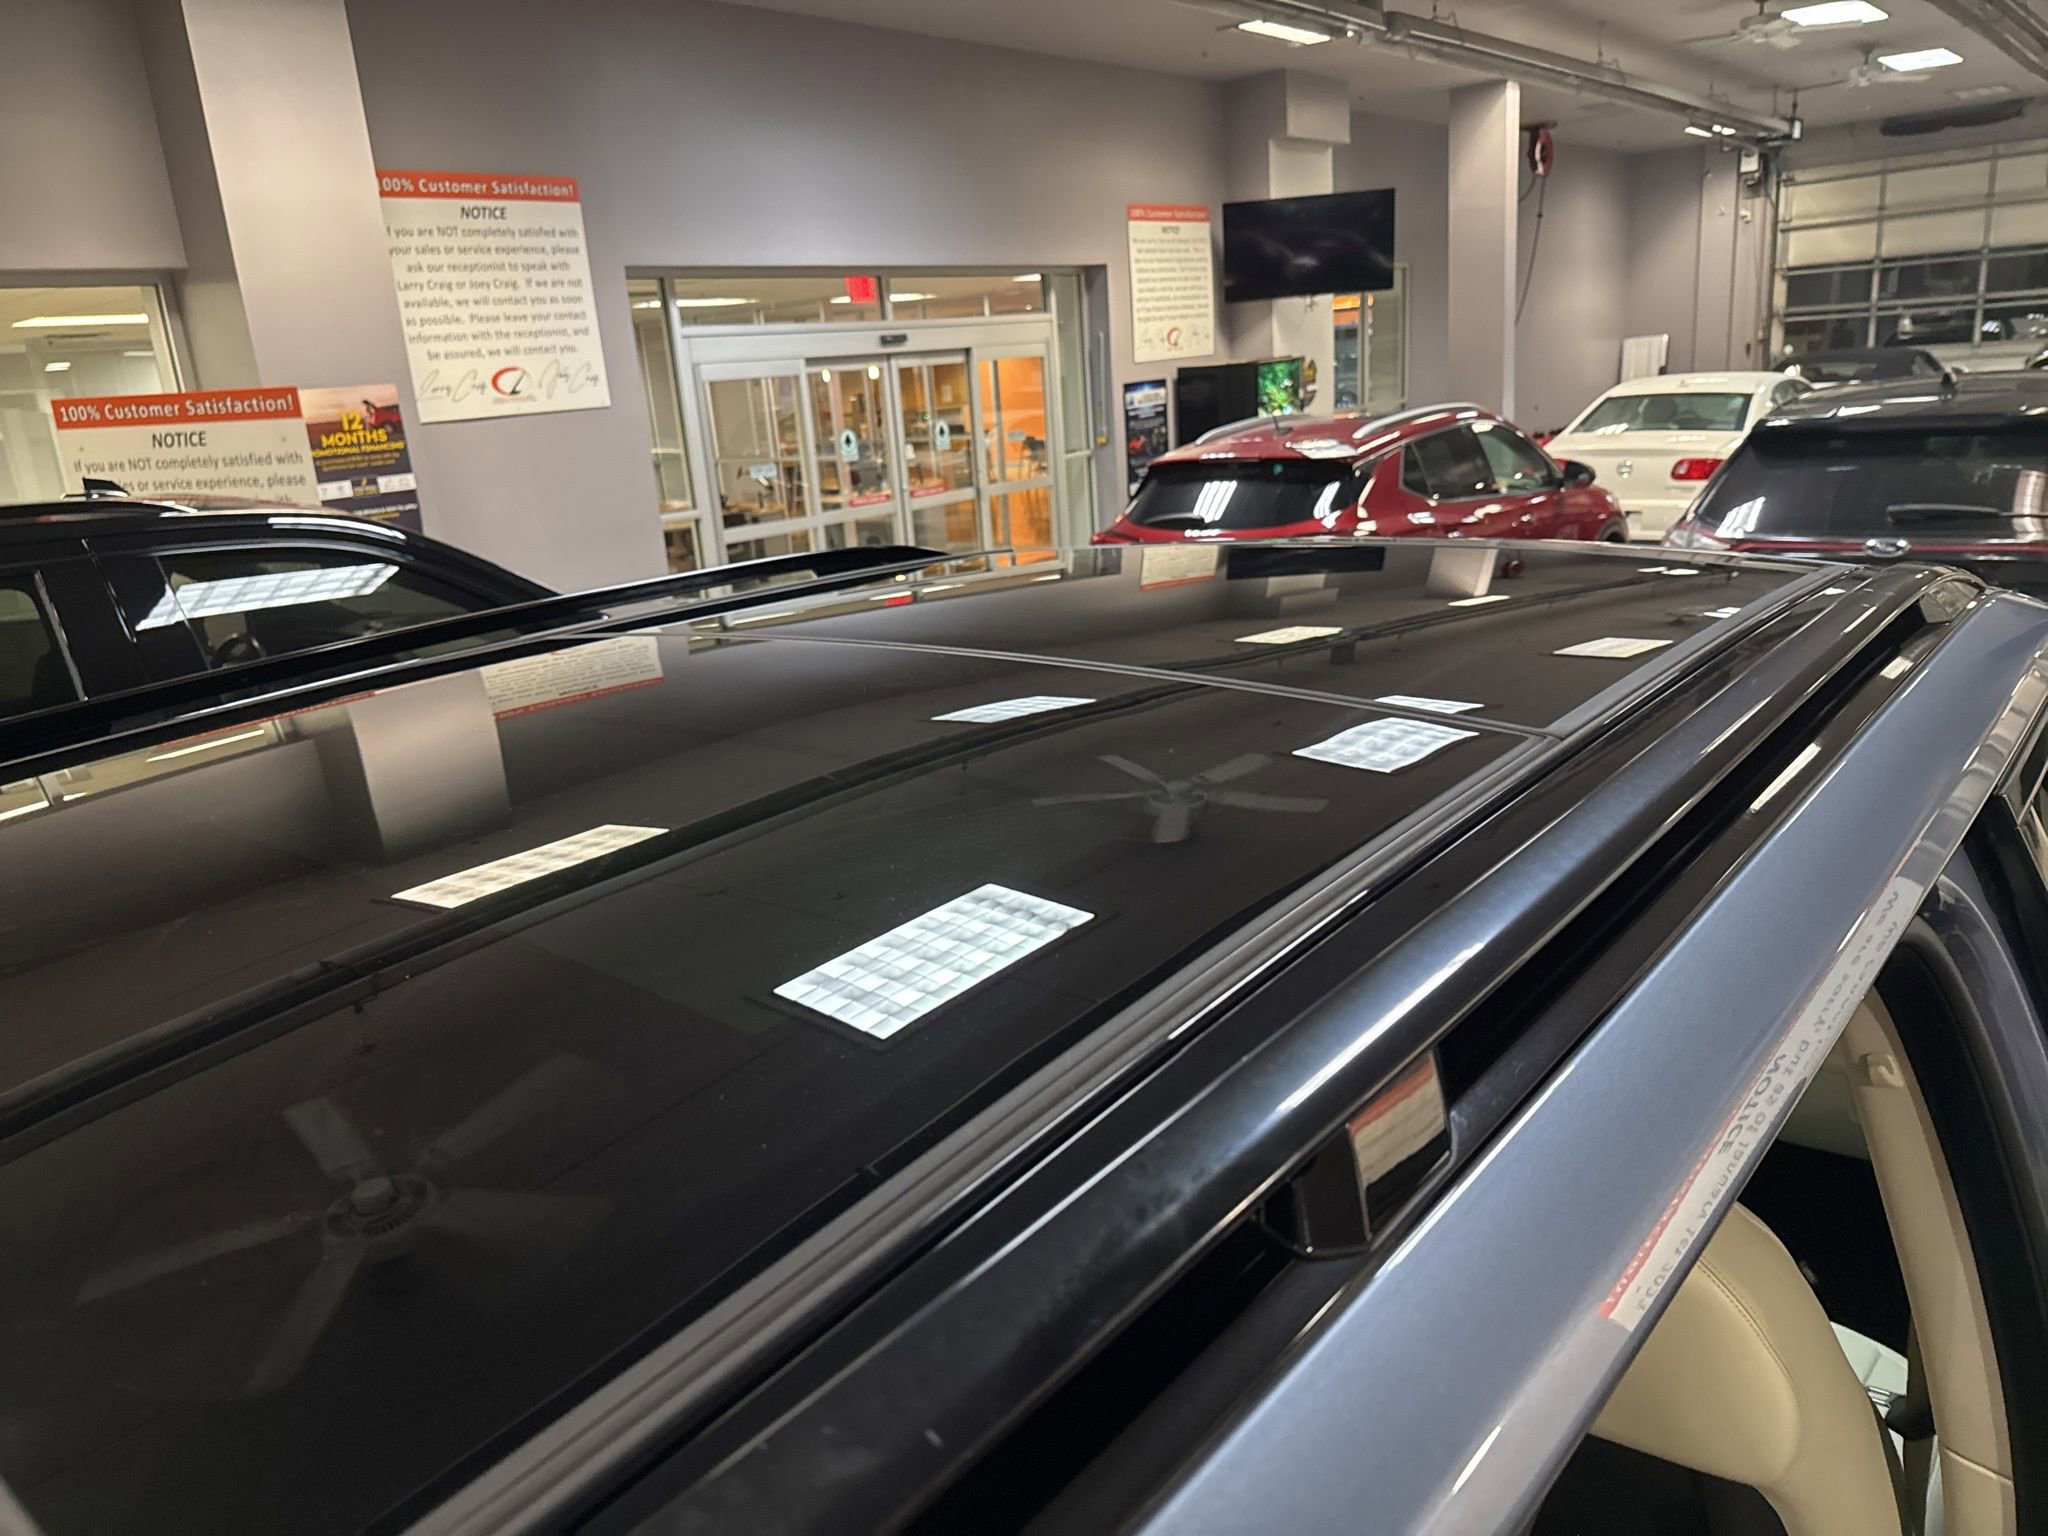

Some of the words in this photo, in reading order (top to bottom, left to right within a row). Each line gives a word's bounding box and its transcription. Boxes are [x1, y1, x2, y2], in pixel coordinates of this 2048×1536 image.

[379, 176, 415, 193] 00%
[418, 177, 487, 194] Customer
[491, 180, 574, 198] Satisfaction!
[460, 205, 508, 220] NOTICE
[394, 227, 415, 240] you
[418, 227, 435, 238] are
[437, 225, 459, 238] NOT
[461, 226, 516, 241] completely
[518, 226, 557, 239] satisfied
[558, 227, 580, 239] with
[389, 246, 411, 258] your
[414, 243, 441, 256] sales
[443, 246, 455, 256] or
[457, 244, 492, 256] service
[551, 244, 580, 257] please
[406, 262, 424, 274] ask
[426, 263, 444, 274] our
[507, 261, 519, 273] to
[521, 262, 547, 275] speak
[549, 261, 570, 273] with
[398, 280, 425, 293] Larry
[427, 279, 453, 293] Craig
[455, 281, 466, 291] or
[534, 280, 548, 290] we
[550, 279, 566, 289] are
[567, 278, 584, 289] not
[455, 298, 469, 308] we
[472, 296, 490, 306] will
[492, 296, 528, 307] contact
[530, 296, 548, 308] you
[469, 312, 501, 325] Please
[503, 311, 529, 324] leave
[530, 311, 552, 325] your
[471, 329, 491, 342] with
[60, 404, 100, 422] 100%
[104, 402, 180, 420] Customer
[185, 393, 294, 416] Satisfaction!
[341, 411, 364, 431] 12
[152, 431, 207, 449] NOTICE
[320, 427, 388, 449] MONTHS
[74, 459, 83, 473] If
[84, 461, 106, 475] you
[108, 461, 126, 472] are
[128, 457, 152, 471] NOT
[155, 454, 219, 472] completely
[222, 451, 273, 469] satisfied
[275, 450, 303, 465] with
[137, 482, 149, 492] or
[152, 478, 193, 491] service
[195, 474, 265, 491] experience,
[267, 472, 306, 490] please
